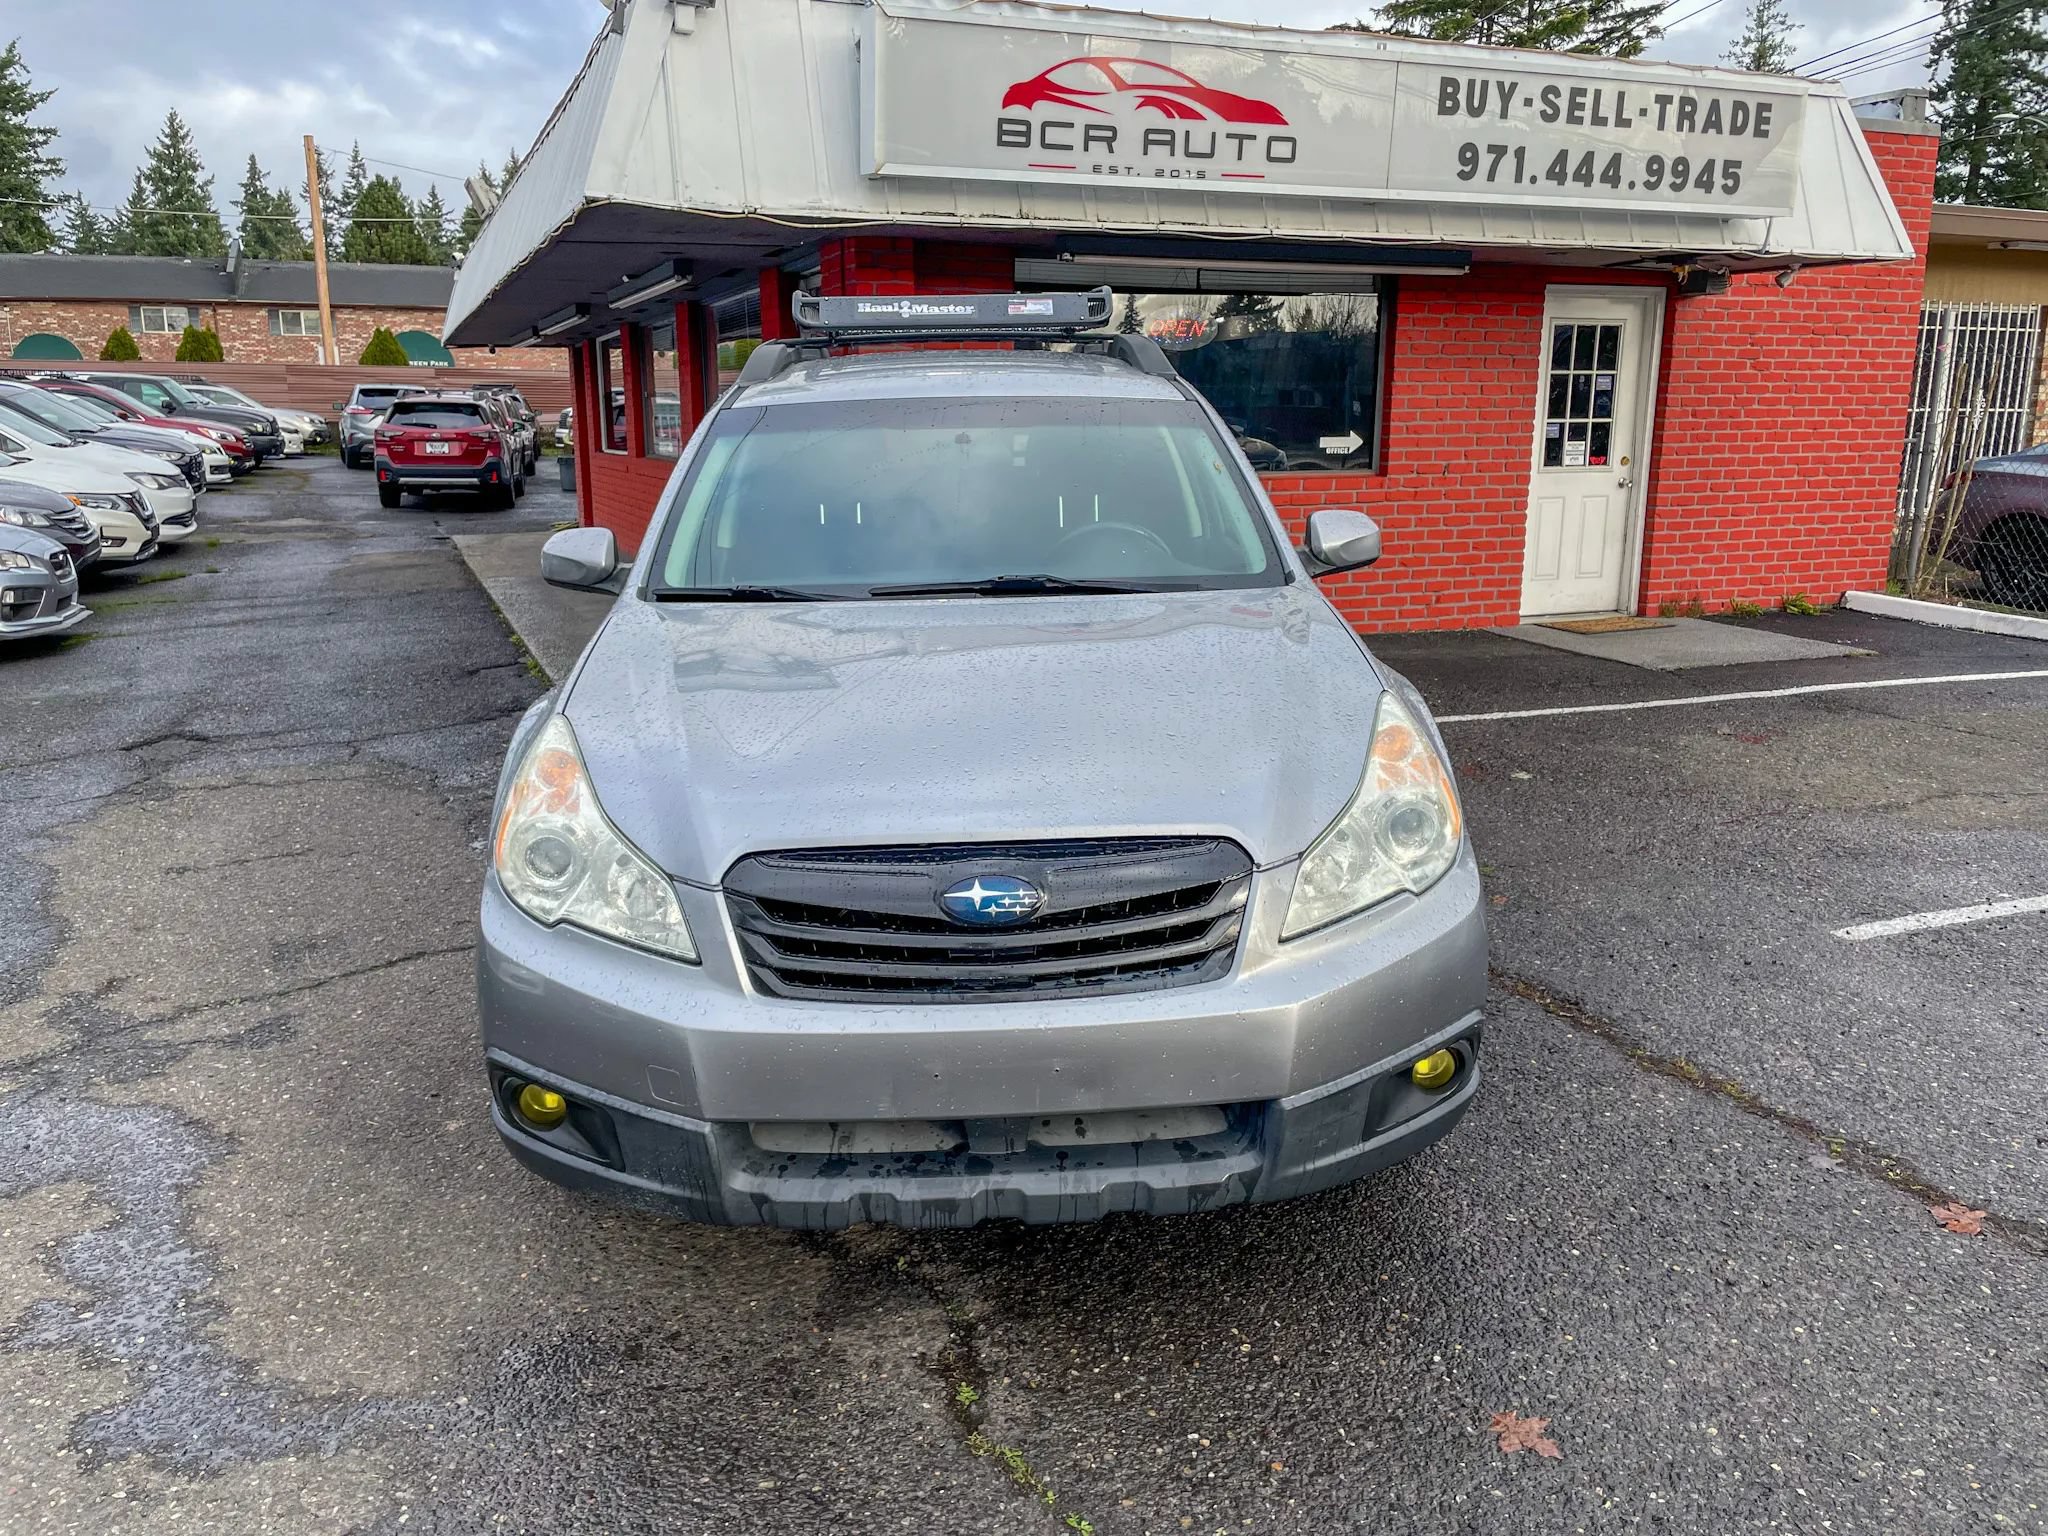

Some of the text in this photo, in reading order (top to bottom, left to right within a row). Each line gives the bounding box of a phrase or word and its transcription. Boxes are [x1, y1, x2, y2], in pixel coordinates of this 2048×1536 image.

[997, 117, 1297, 164] BCR AUTO
[1092, 164, 1206, 179] EST. 2015
[1456, 142, 1743, 196] 971.444.9945
[857, 302, 977, 315] Haul Master
[1150, 319, 1209, 337] OPEN
[1325, 447, 1349, 455] OFFICE
